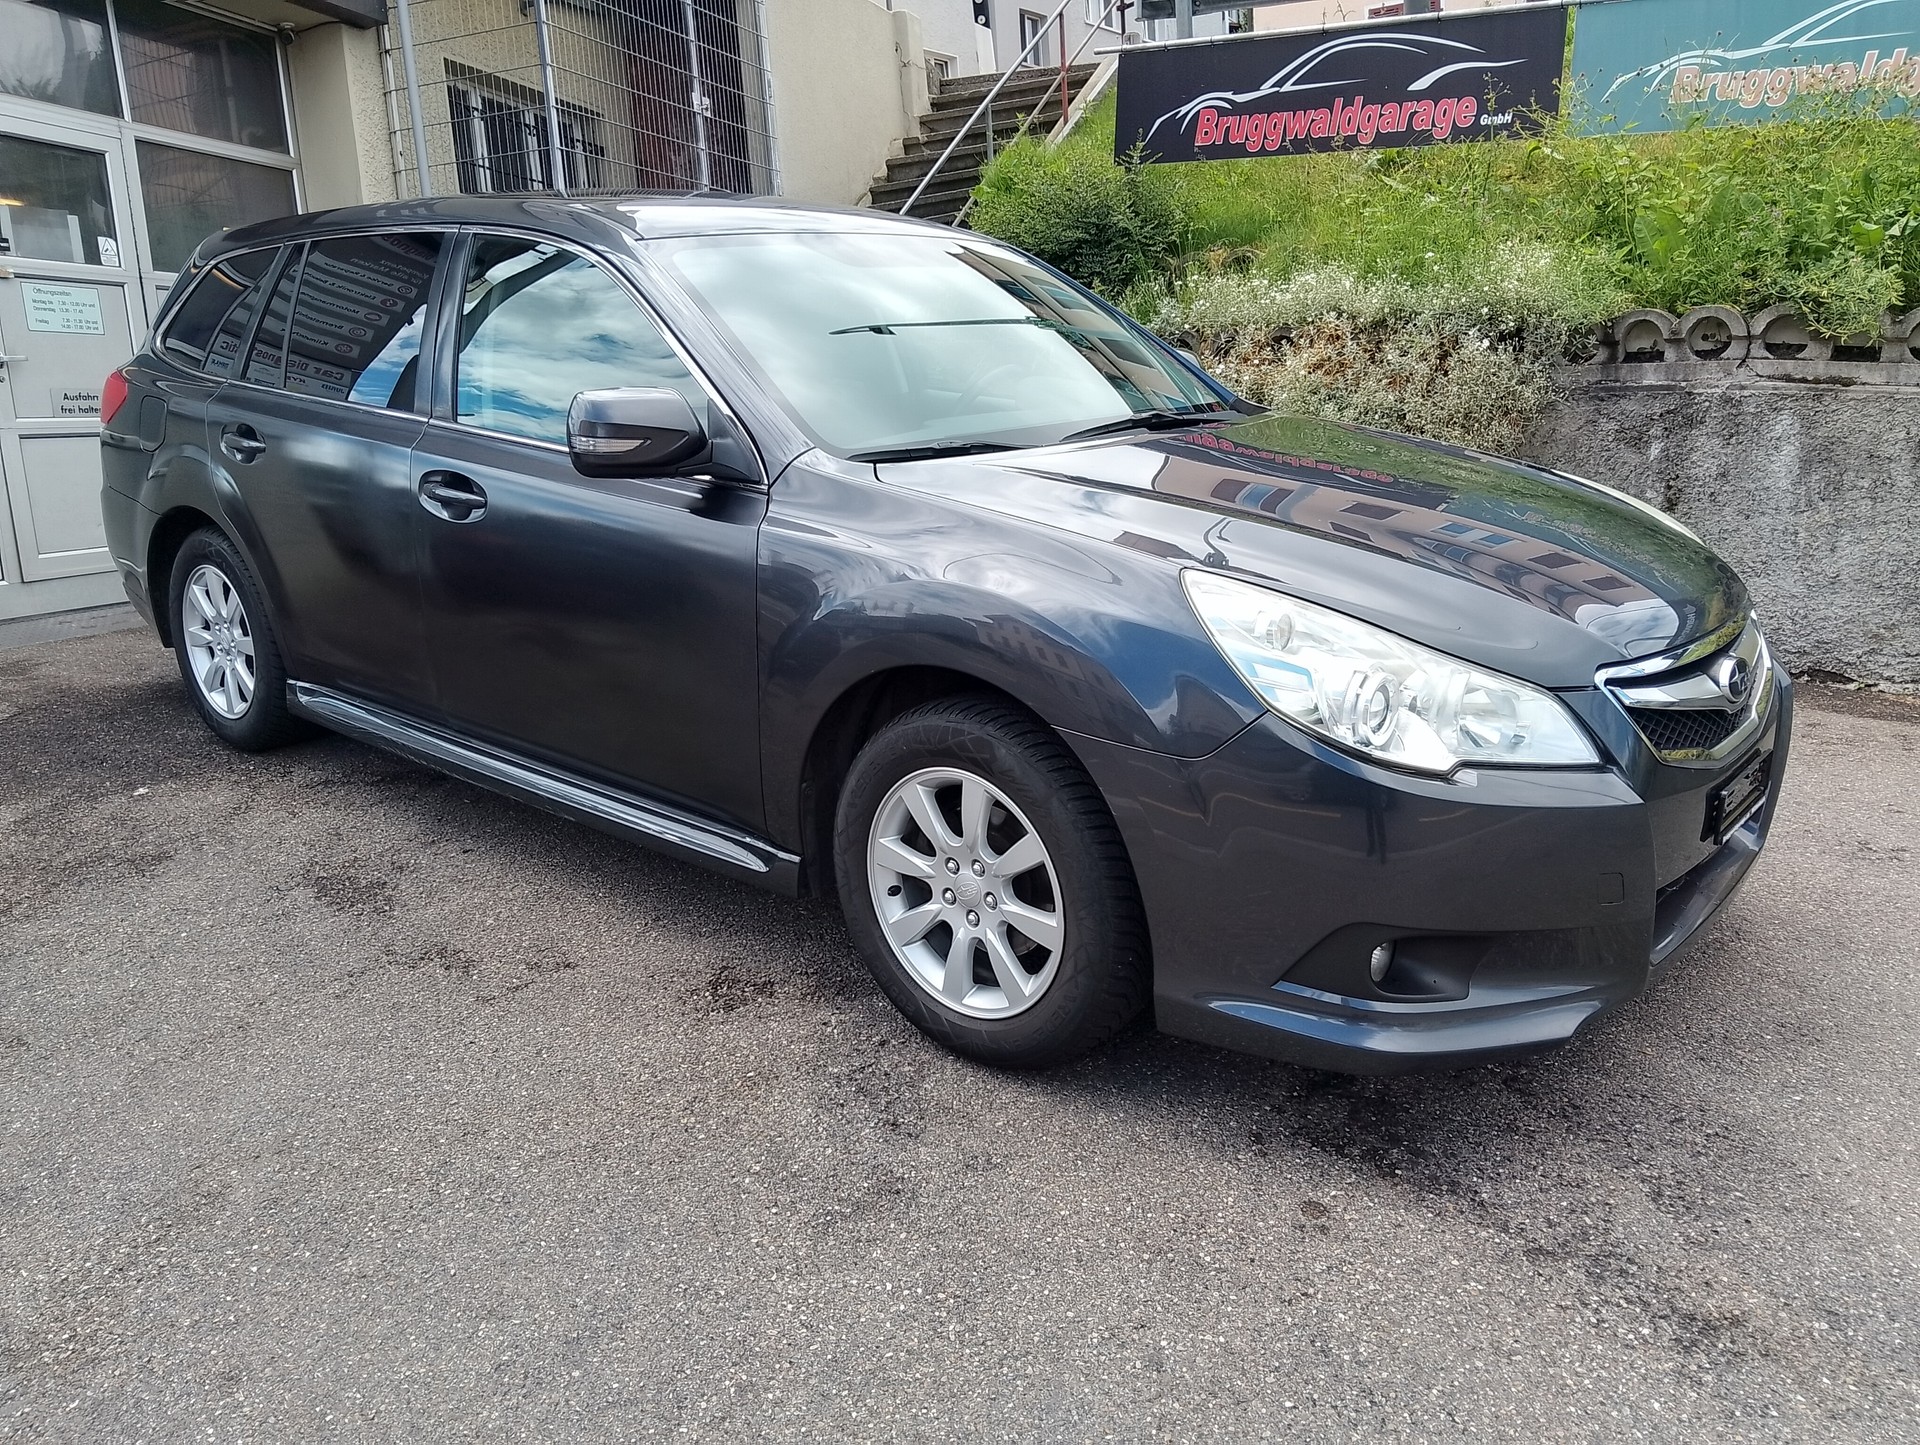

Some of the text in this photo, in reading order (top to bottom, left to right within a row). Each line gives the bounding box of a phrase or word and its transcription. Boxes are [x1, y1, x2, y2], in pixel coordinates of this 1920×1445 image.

[1195, 96, 1513, 152] Bruggwaldgarage GmbH
[61, 405, 75, 414] frei
